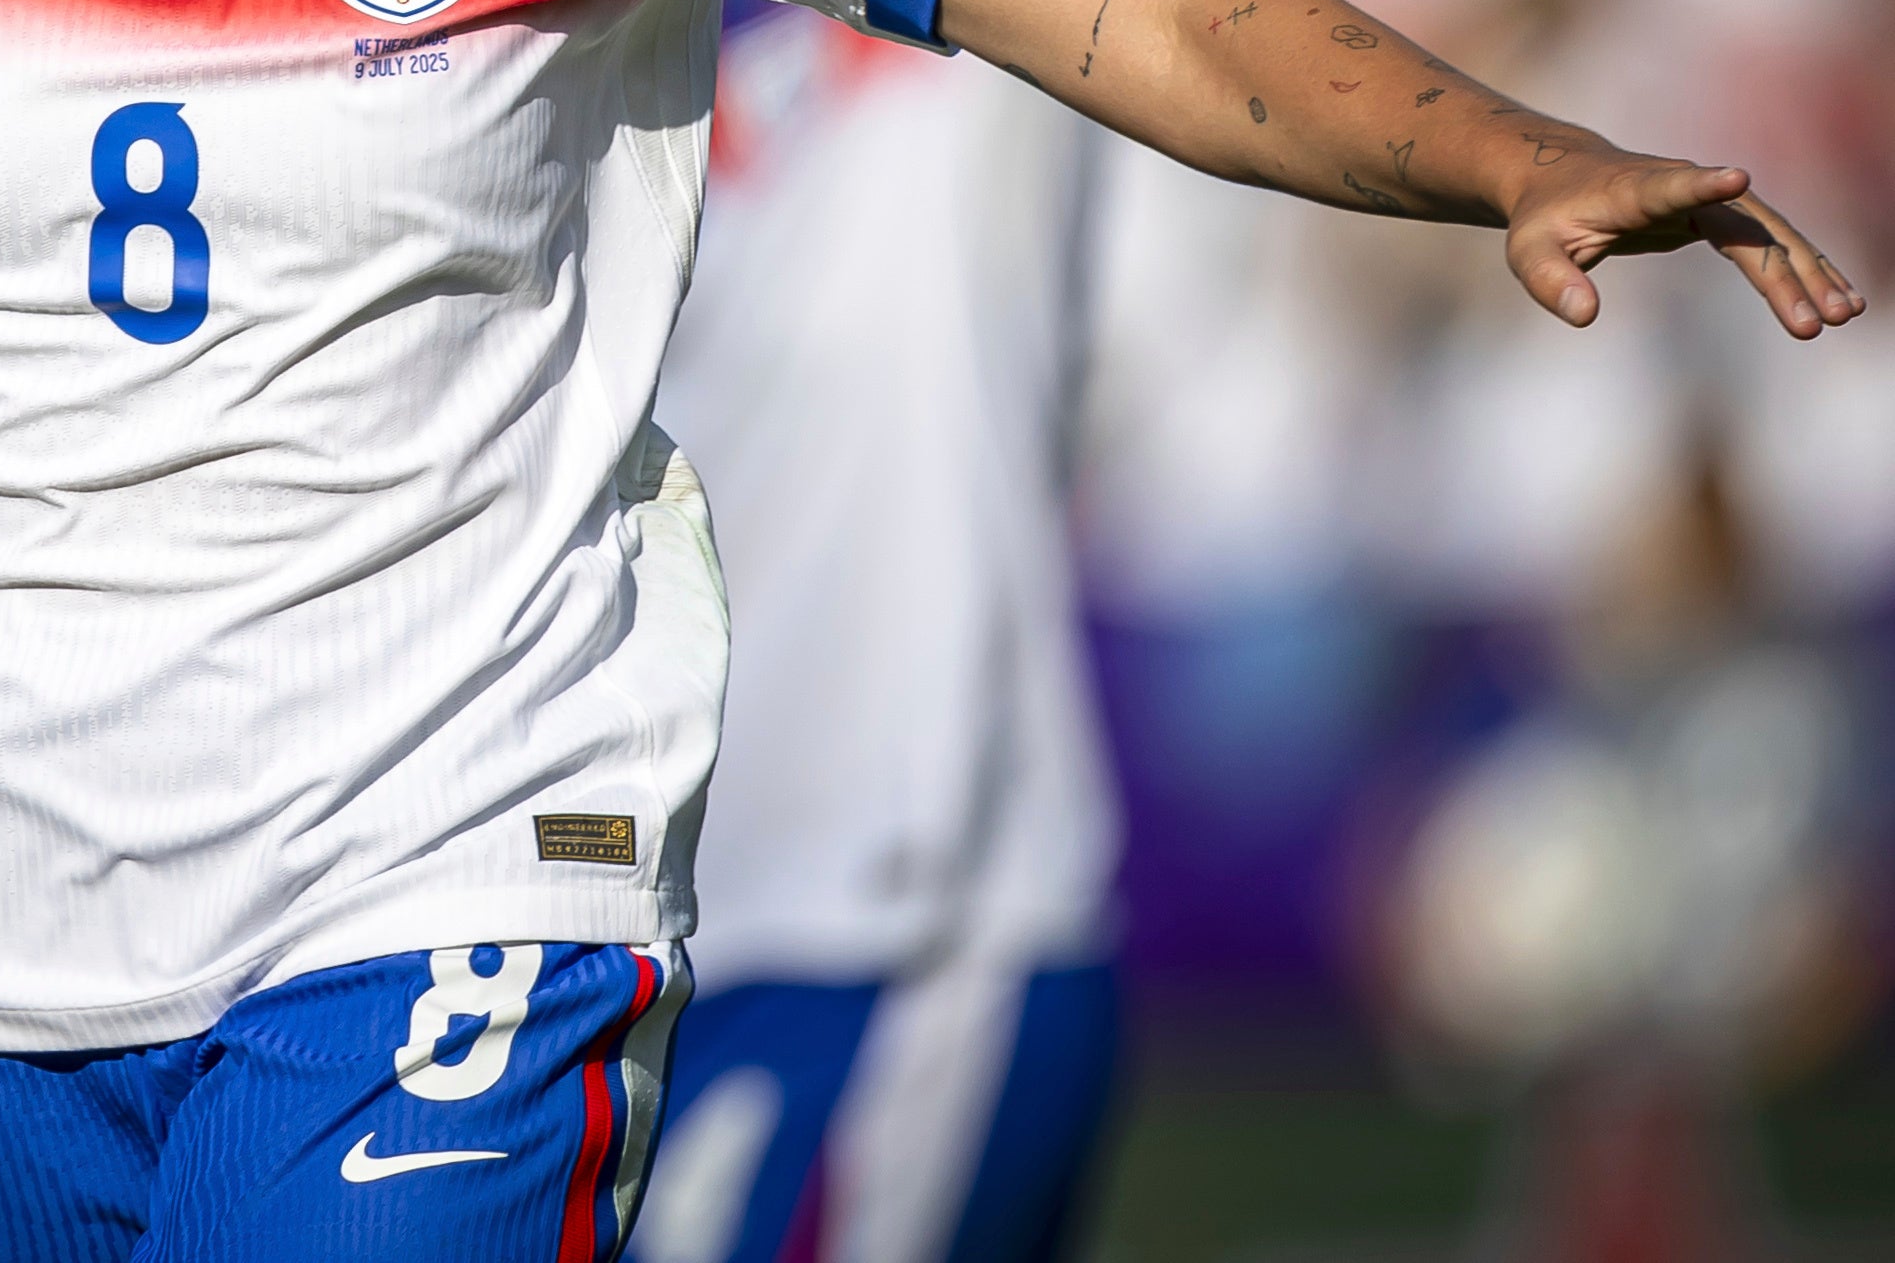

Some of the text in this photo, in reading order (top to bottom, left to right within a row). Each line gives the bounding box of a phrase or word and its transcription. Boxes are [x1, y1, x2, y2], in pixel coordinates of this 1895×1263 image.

[354, 28, 449, 57] NETHERLANDS
[354, 51, 450, 79] 9 JULY 2025
[88, 101, 211, 346] 8
[393, 943, 544, 1102] 8
